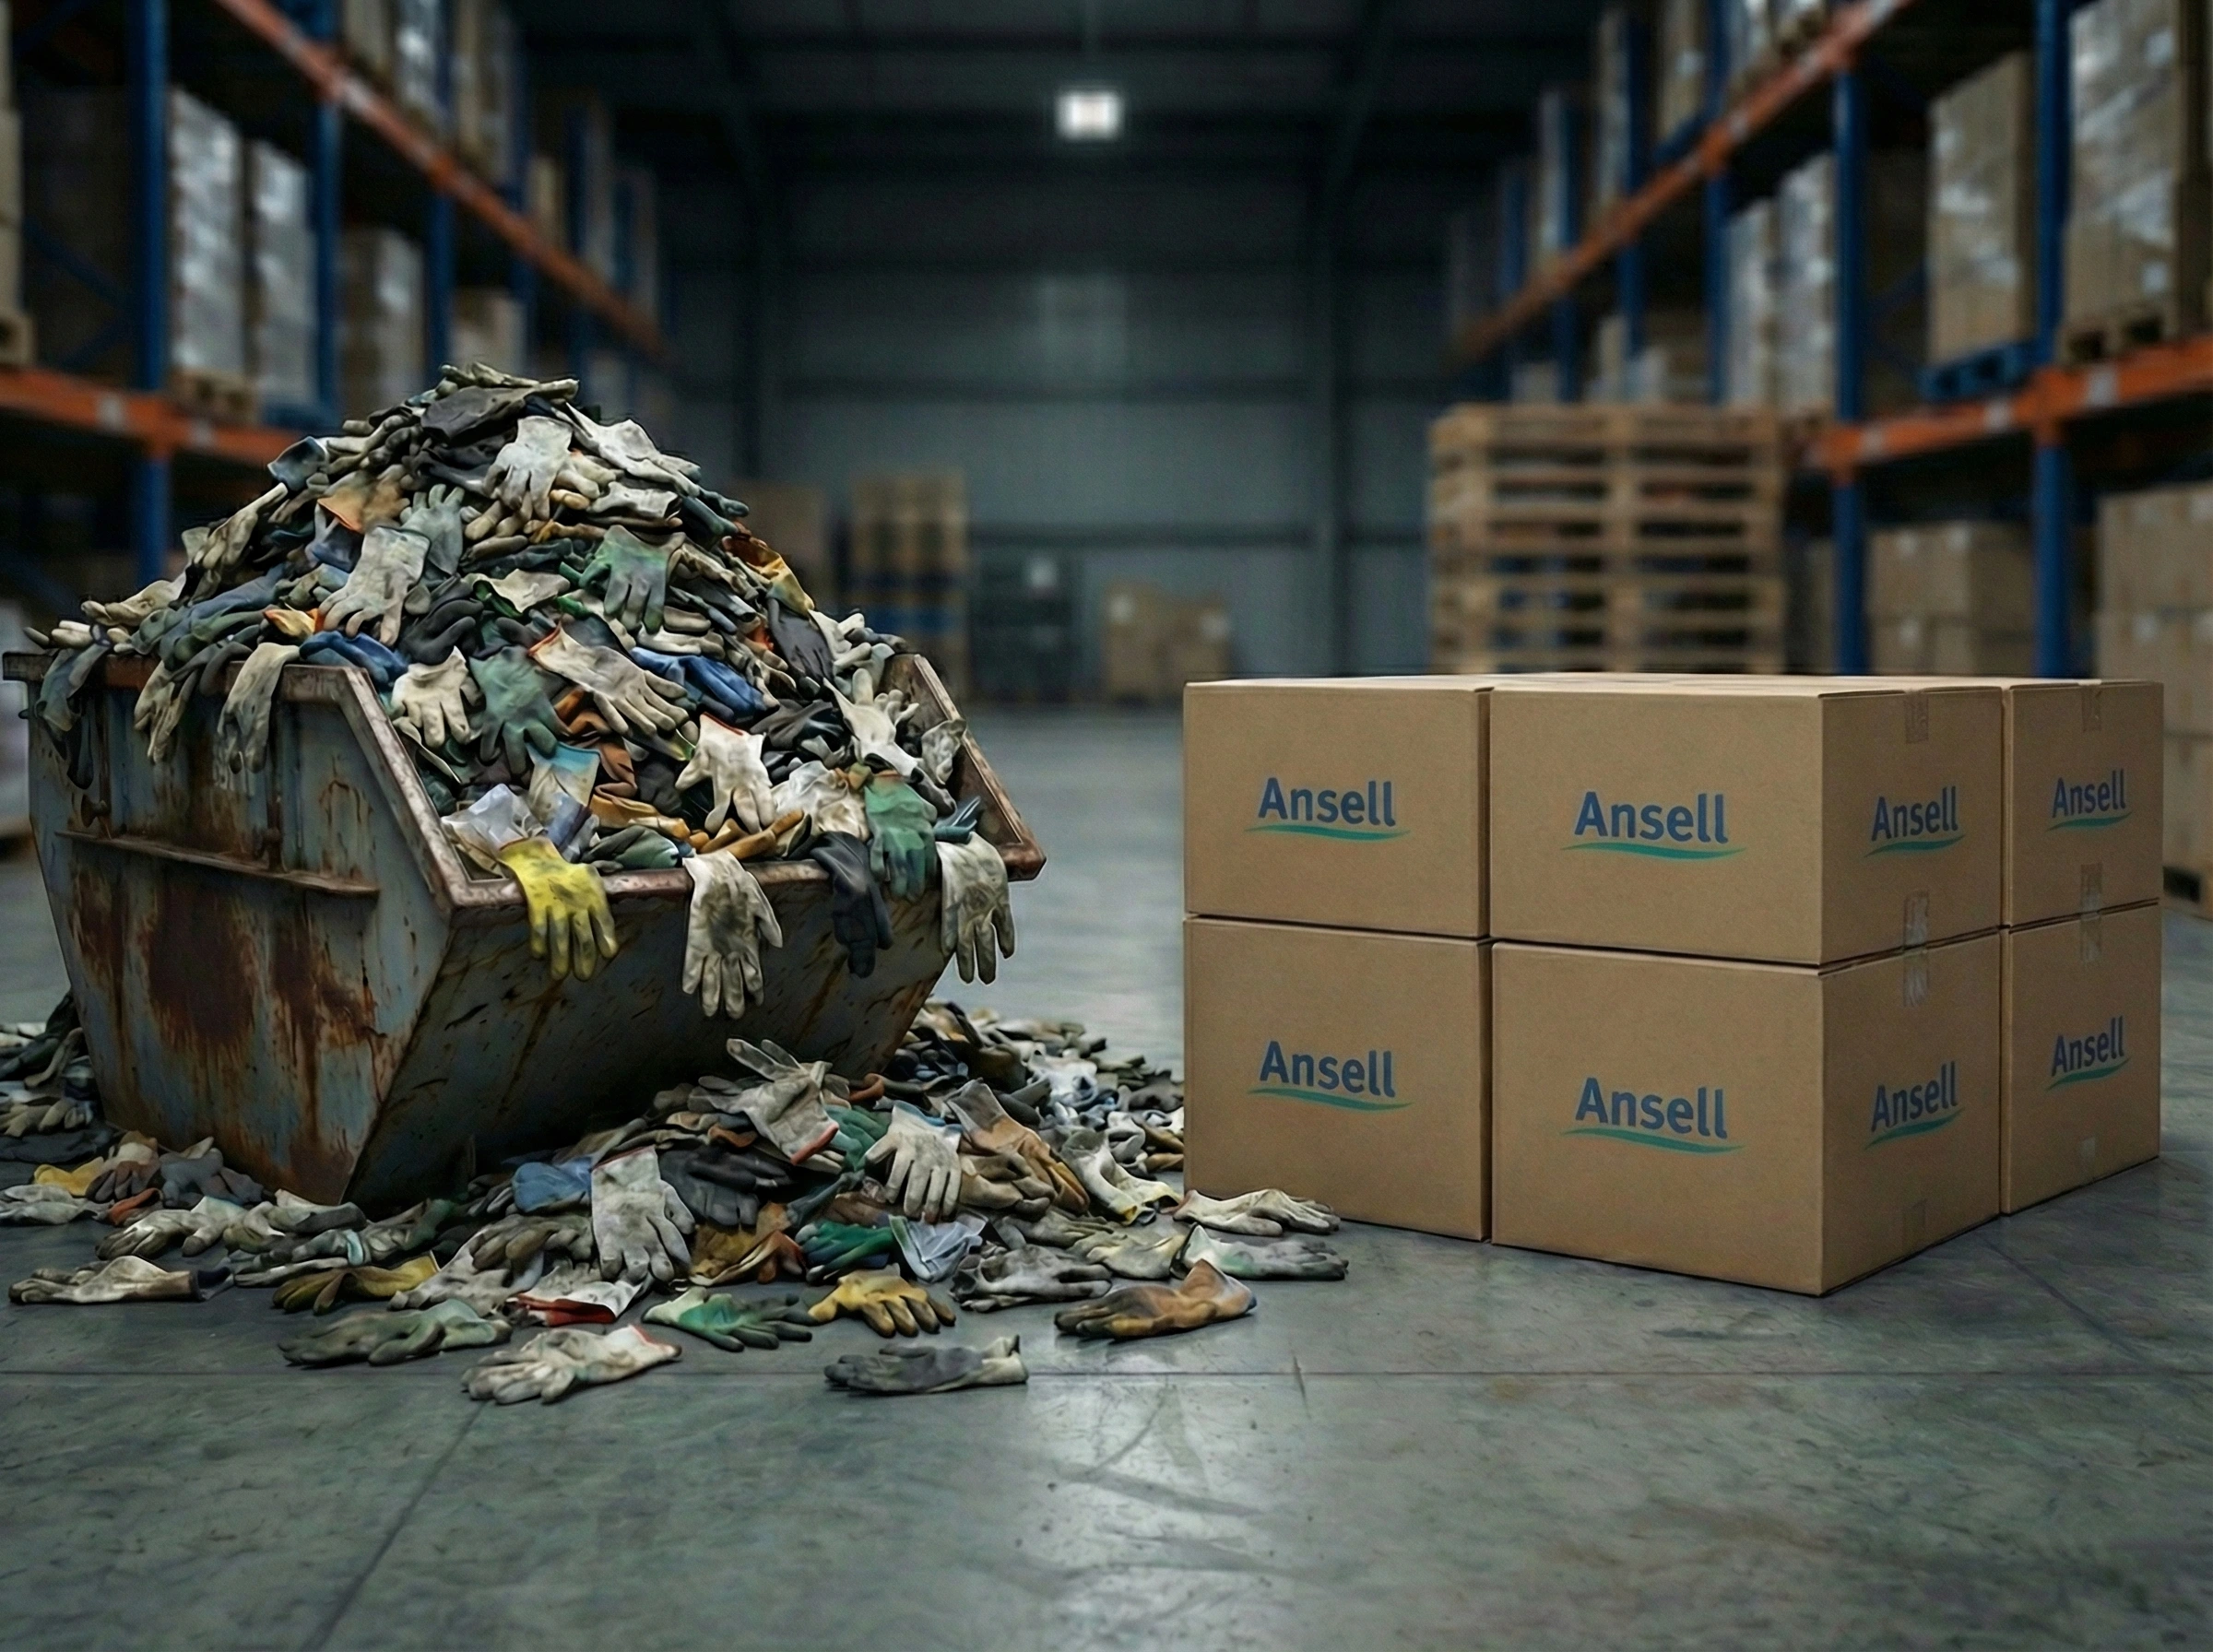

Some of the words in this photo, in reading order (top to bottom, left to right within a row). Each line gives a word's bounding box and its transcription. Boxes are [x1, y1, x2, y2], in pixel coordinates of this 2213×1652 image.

[1258, 778, 1396, 827] Ansell
[1574, 792, 1727, 843] Ansell
[1871, 786, 1959, 841] Ansell
[2052, 770, 2126, 817] Ansell
[1260, 1041, 1395, 1097] Ansell
[2051, 1016, 2124, 1078] Ansell
[1575, 1077, 1727, 1139] Ansell
[1871, 1062, 1957, 1131] Ansell
